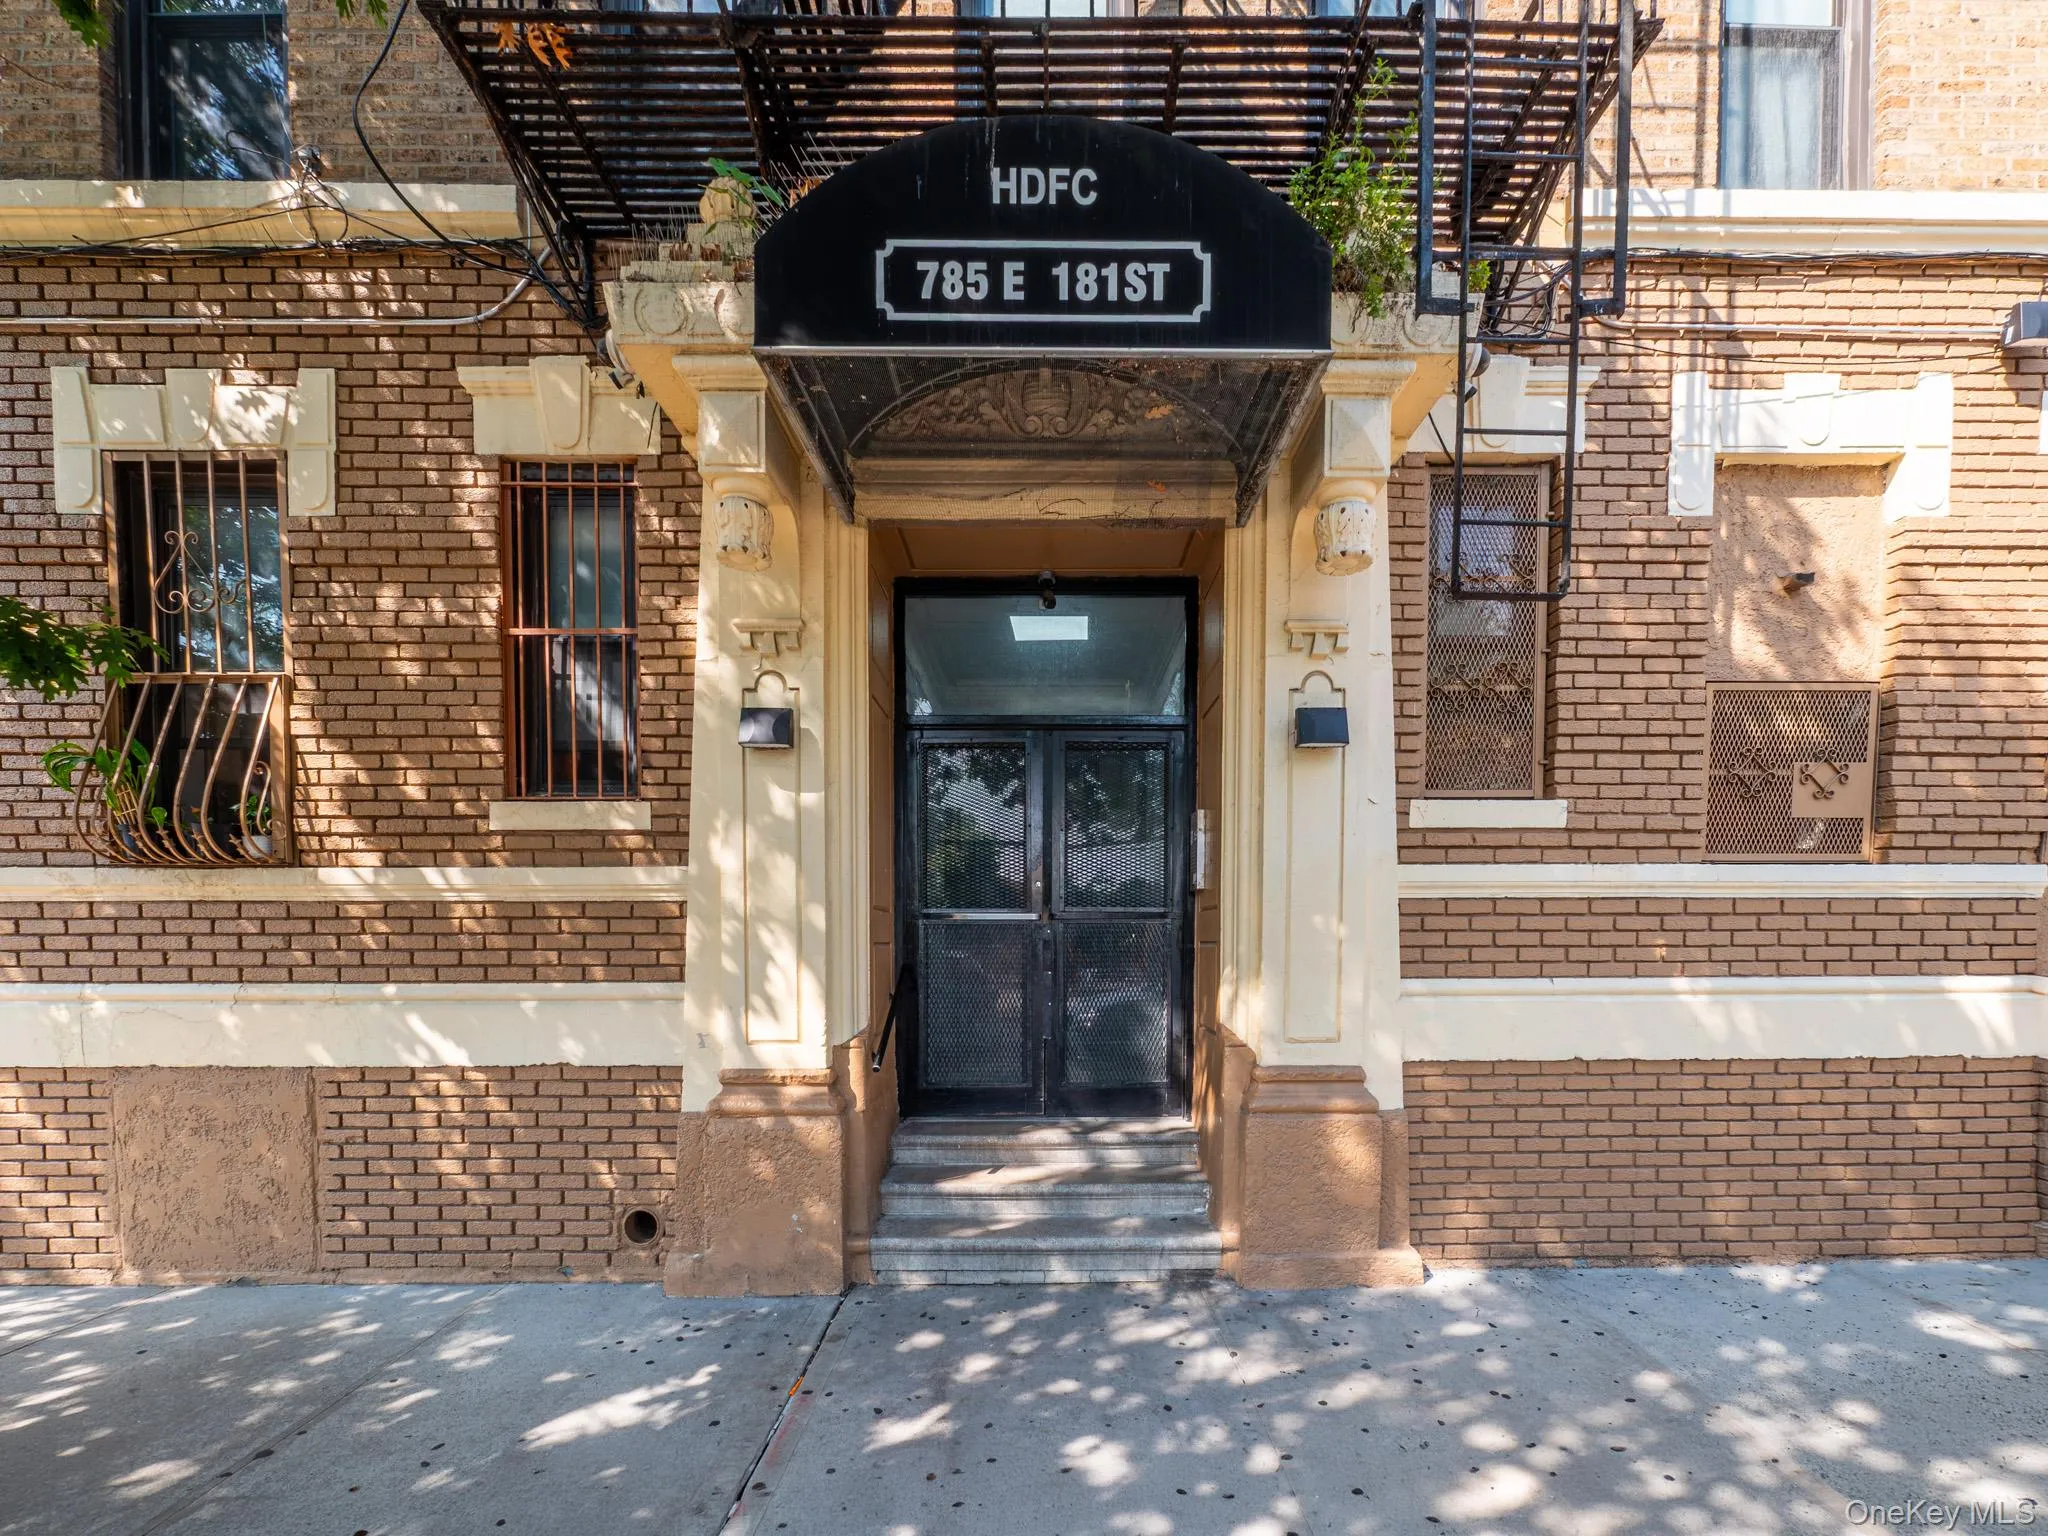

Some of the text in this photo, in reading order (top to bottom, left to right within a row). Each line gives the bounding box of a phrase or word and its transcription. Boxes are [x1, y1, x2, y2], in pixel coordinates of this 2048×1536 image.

[991, 167, 1098, 206] HDFC
[916, 261, 1171, 302] 785 E 181ST
